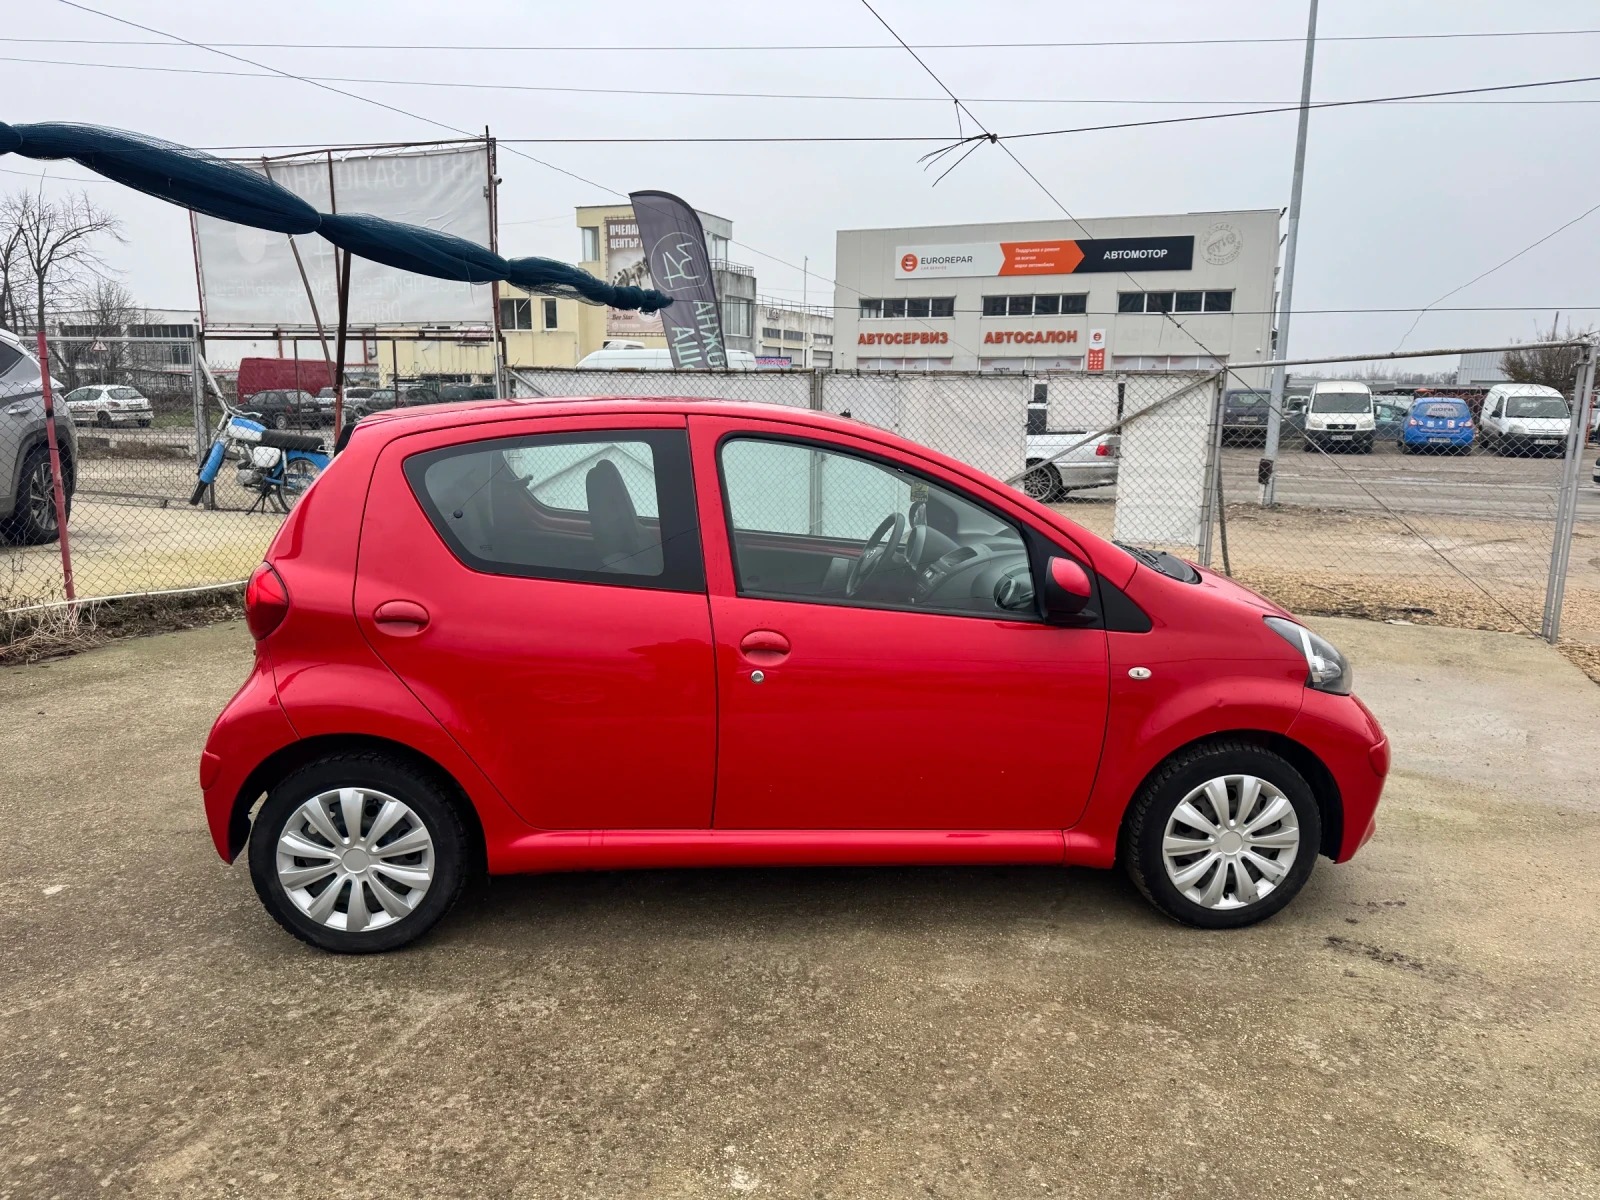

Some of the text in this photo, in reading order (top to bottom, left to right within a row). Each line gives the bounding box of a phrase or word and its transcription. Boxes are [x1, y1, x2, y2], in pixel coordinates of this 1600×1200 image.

[610, 238, 639, 250] ЦЕНТЪР
[920, 256, 973, 265] EUROREPAR
[1103, 249, 1168, 260] АВТОМОТОР
[858, 331, 949, 345] АВТОСЕРВИЗ
[984, 330, 1078, 344] АВТОСАЛОН
